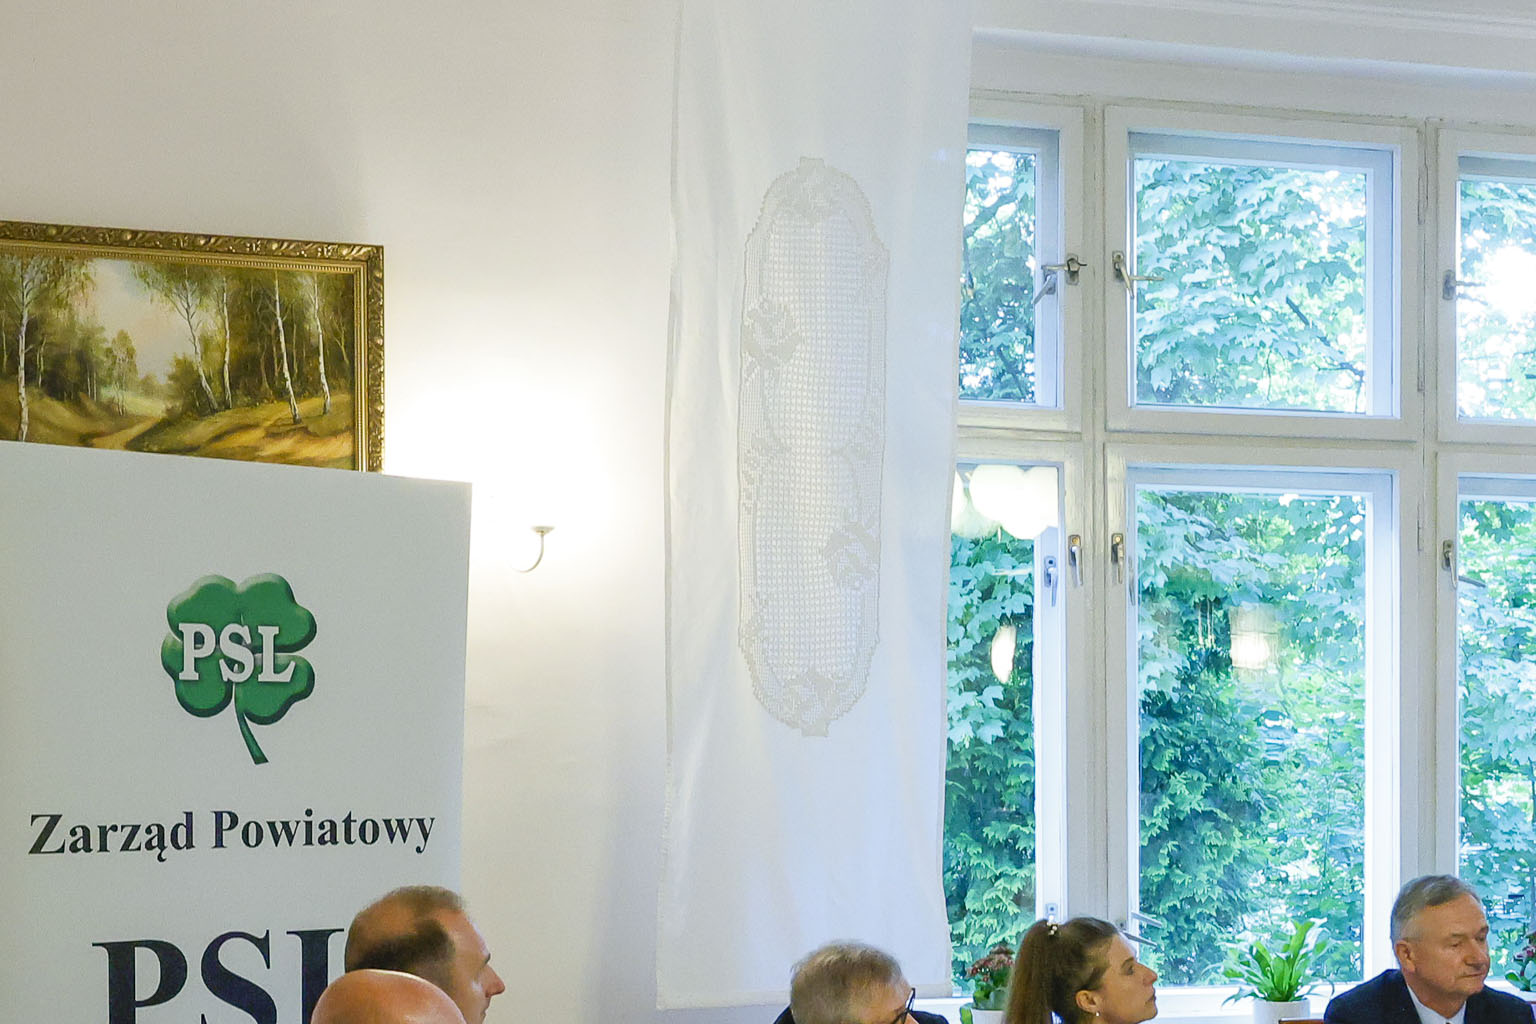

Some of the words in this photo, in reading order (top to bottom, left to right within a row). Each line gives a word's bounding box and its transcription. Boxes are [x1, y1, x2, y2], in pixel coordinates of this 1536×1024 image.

[177, 623, 297, 684] PSL
[28, 811, 195, 862] Zarząd
[212, 808, 436, 853] Powiatowy
